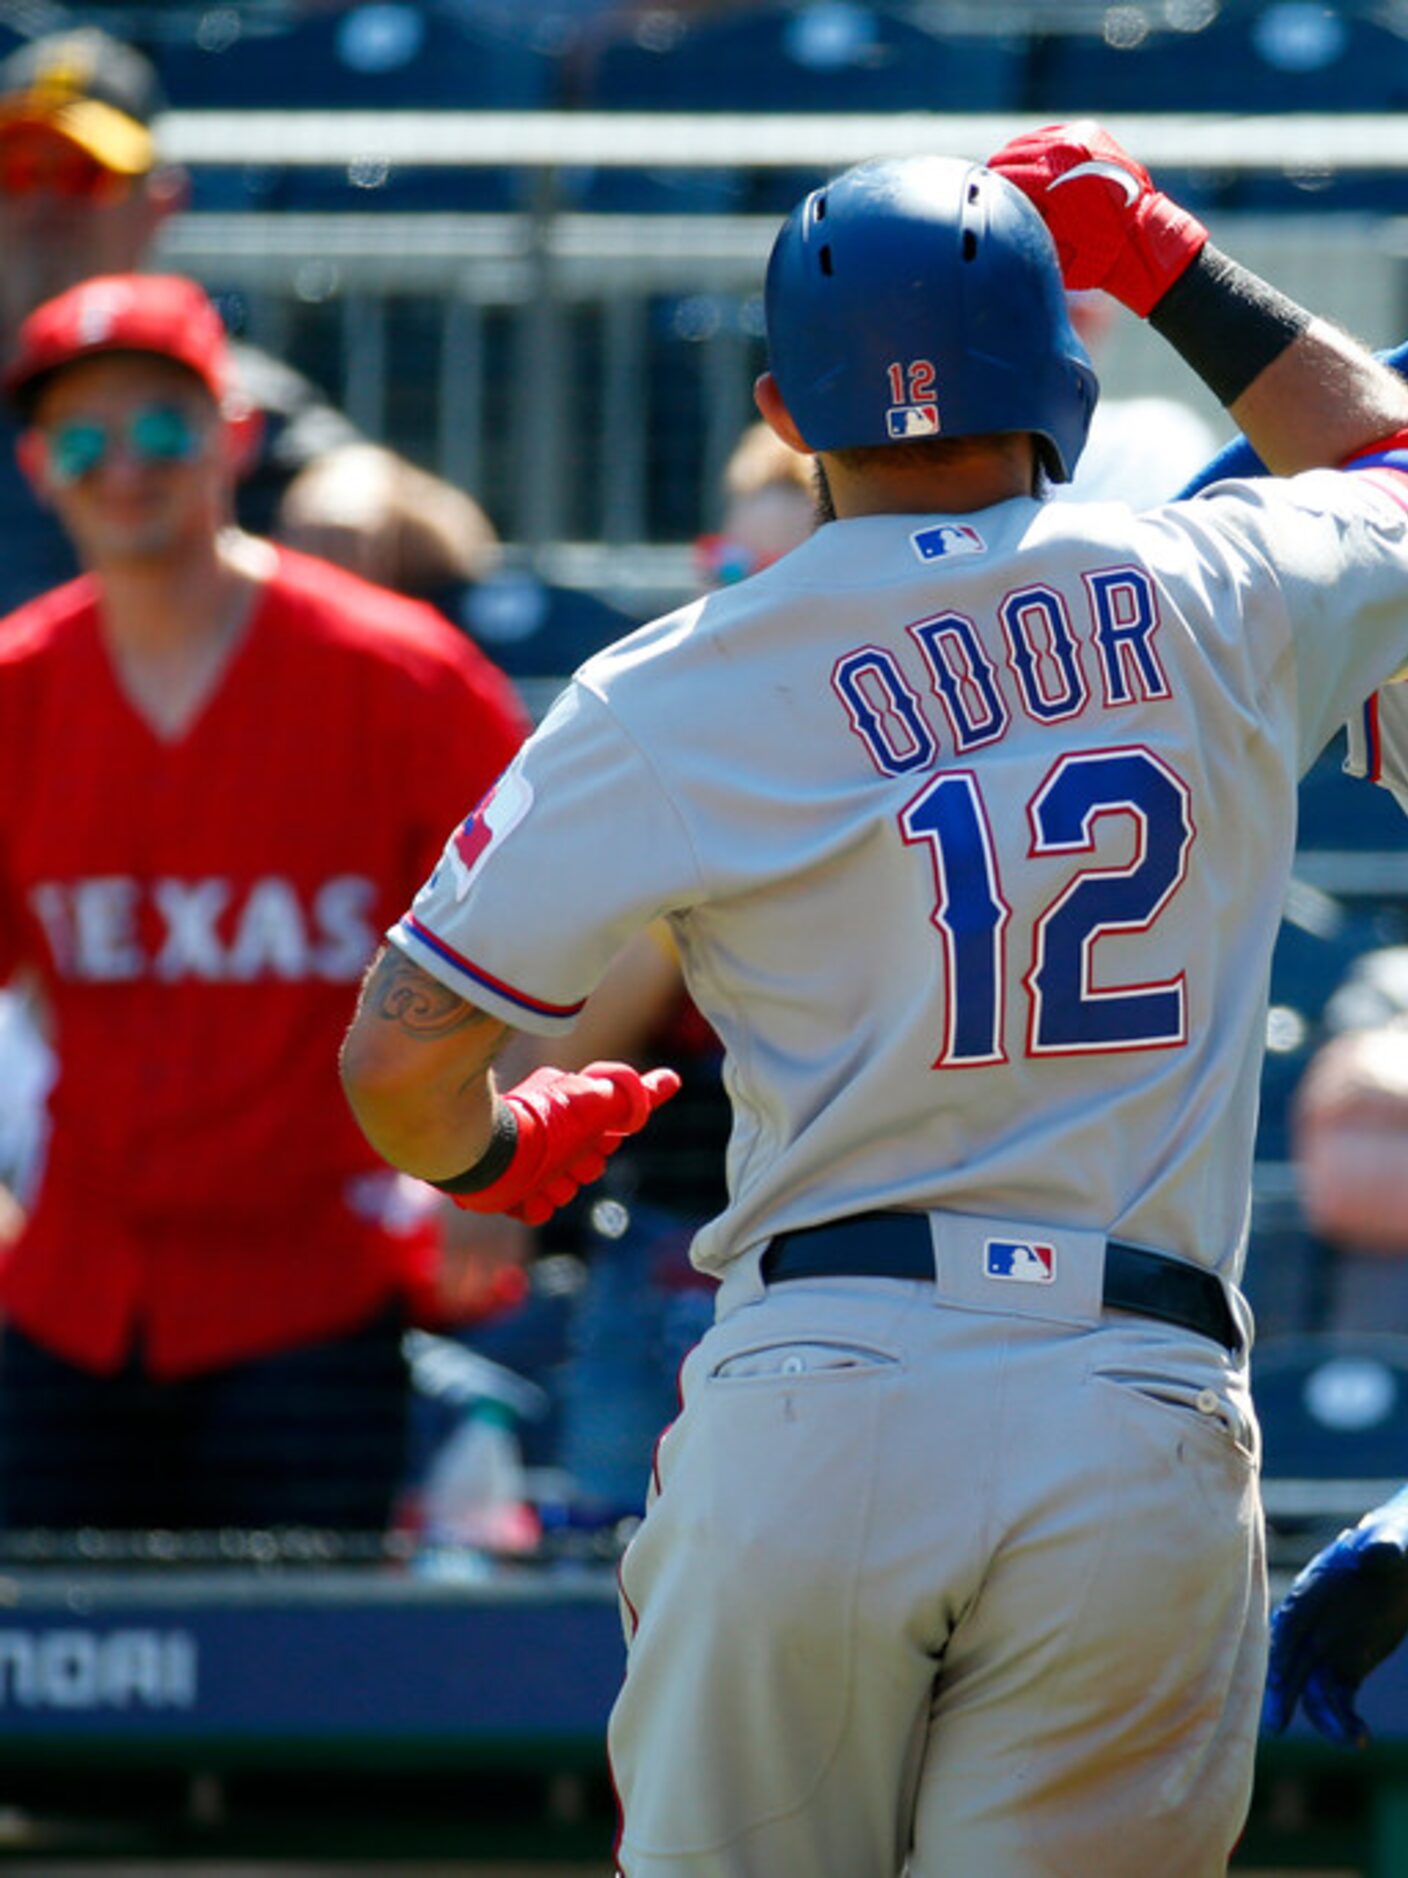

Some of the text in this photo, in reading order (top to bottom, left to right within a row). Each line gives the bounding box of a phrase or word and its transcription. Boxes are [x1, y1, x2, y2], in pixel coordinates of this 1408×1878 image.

[887, 360, 938, 404] 12
[831, 564, 1172, 778] ODOR
[897, 744, 1196, 1069] 12
